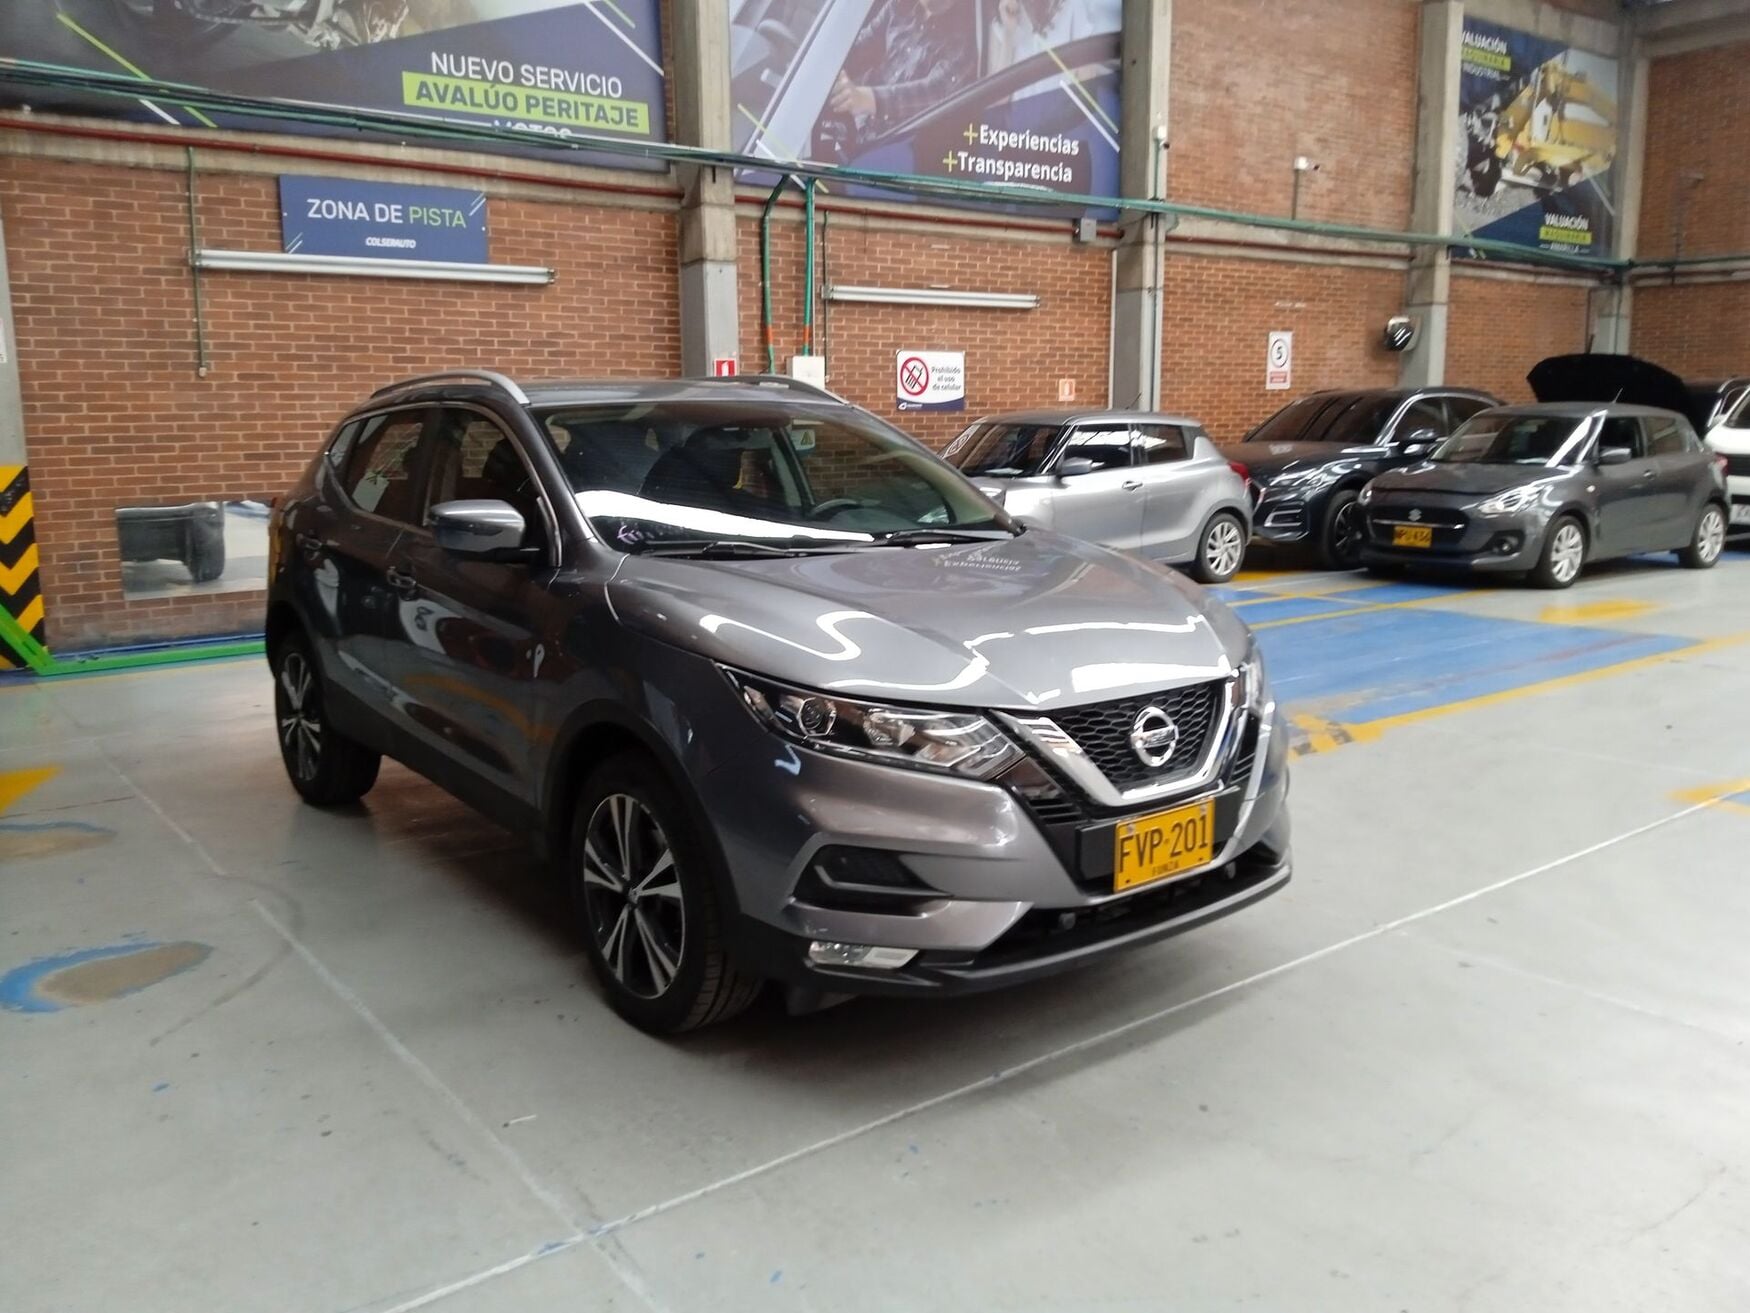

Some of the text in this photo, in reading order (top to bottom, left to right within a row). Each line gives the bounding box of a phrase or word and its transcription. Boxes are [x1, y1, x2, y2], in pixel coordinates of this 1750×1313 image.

[431, 51, 622, 98] NUEVO SERVICIO
[415, 80, 639, 128] AVALÚO PERITAJE
[306, 198, 467, 228] ZONA DE PISTA
